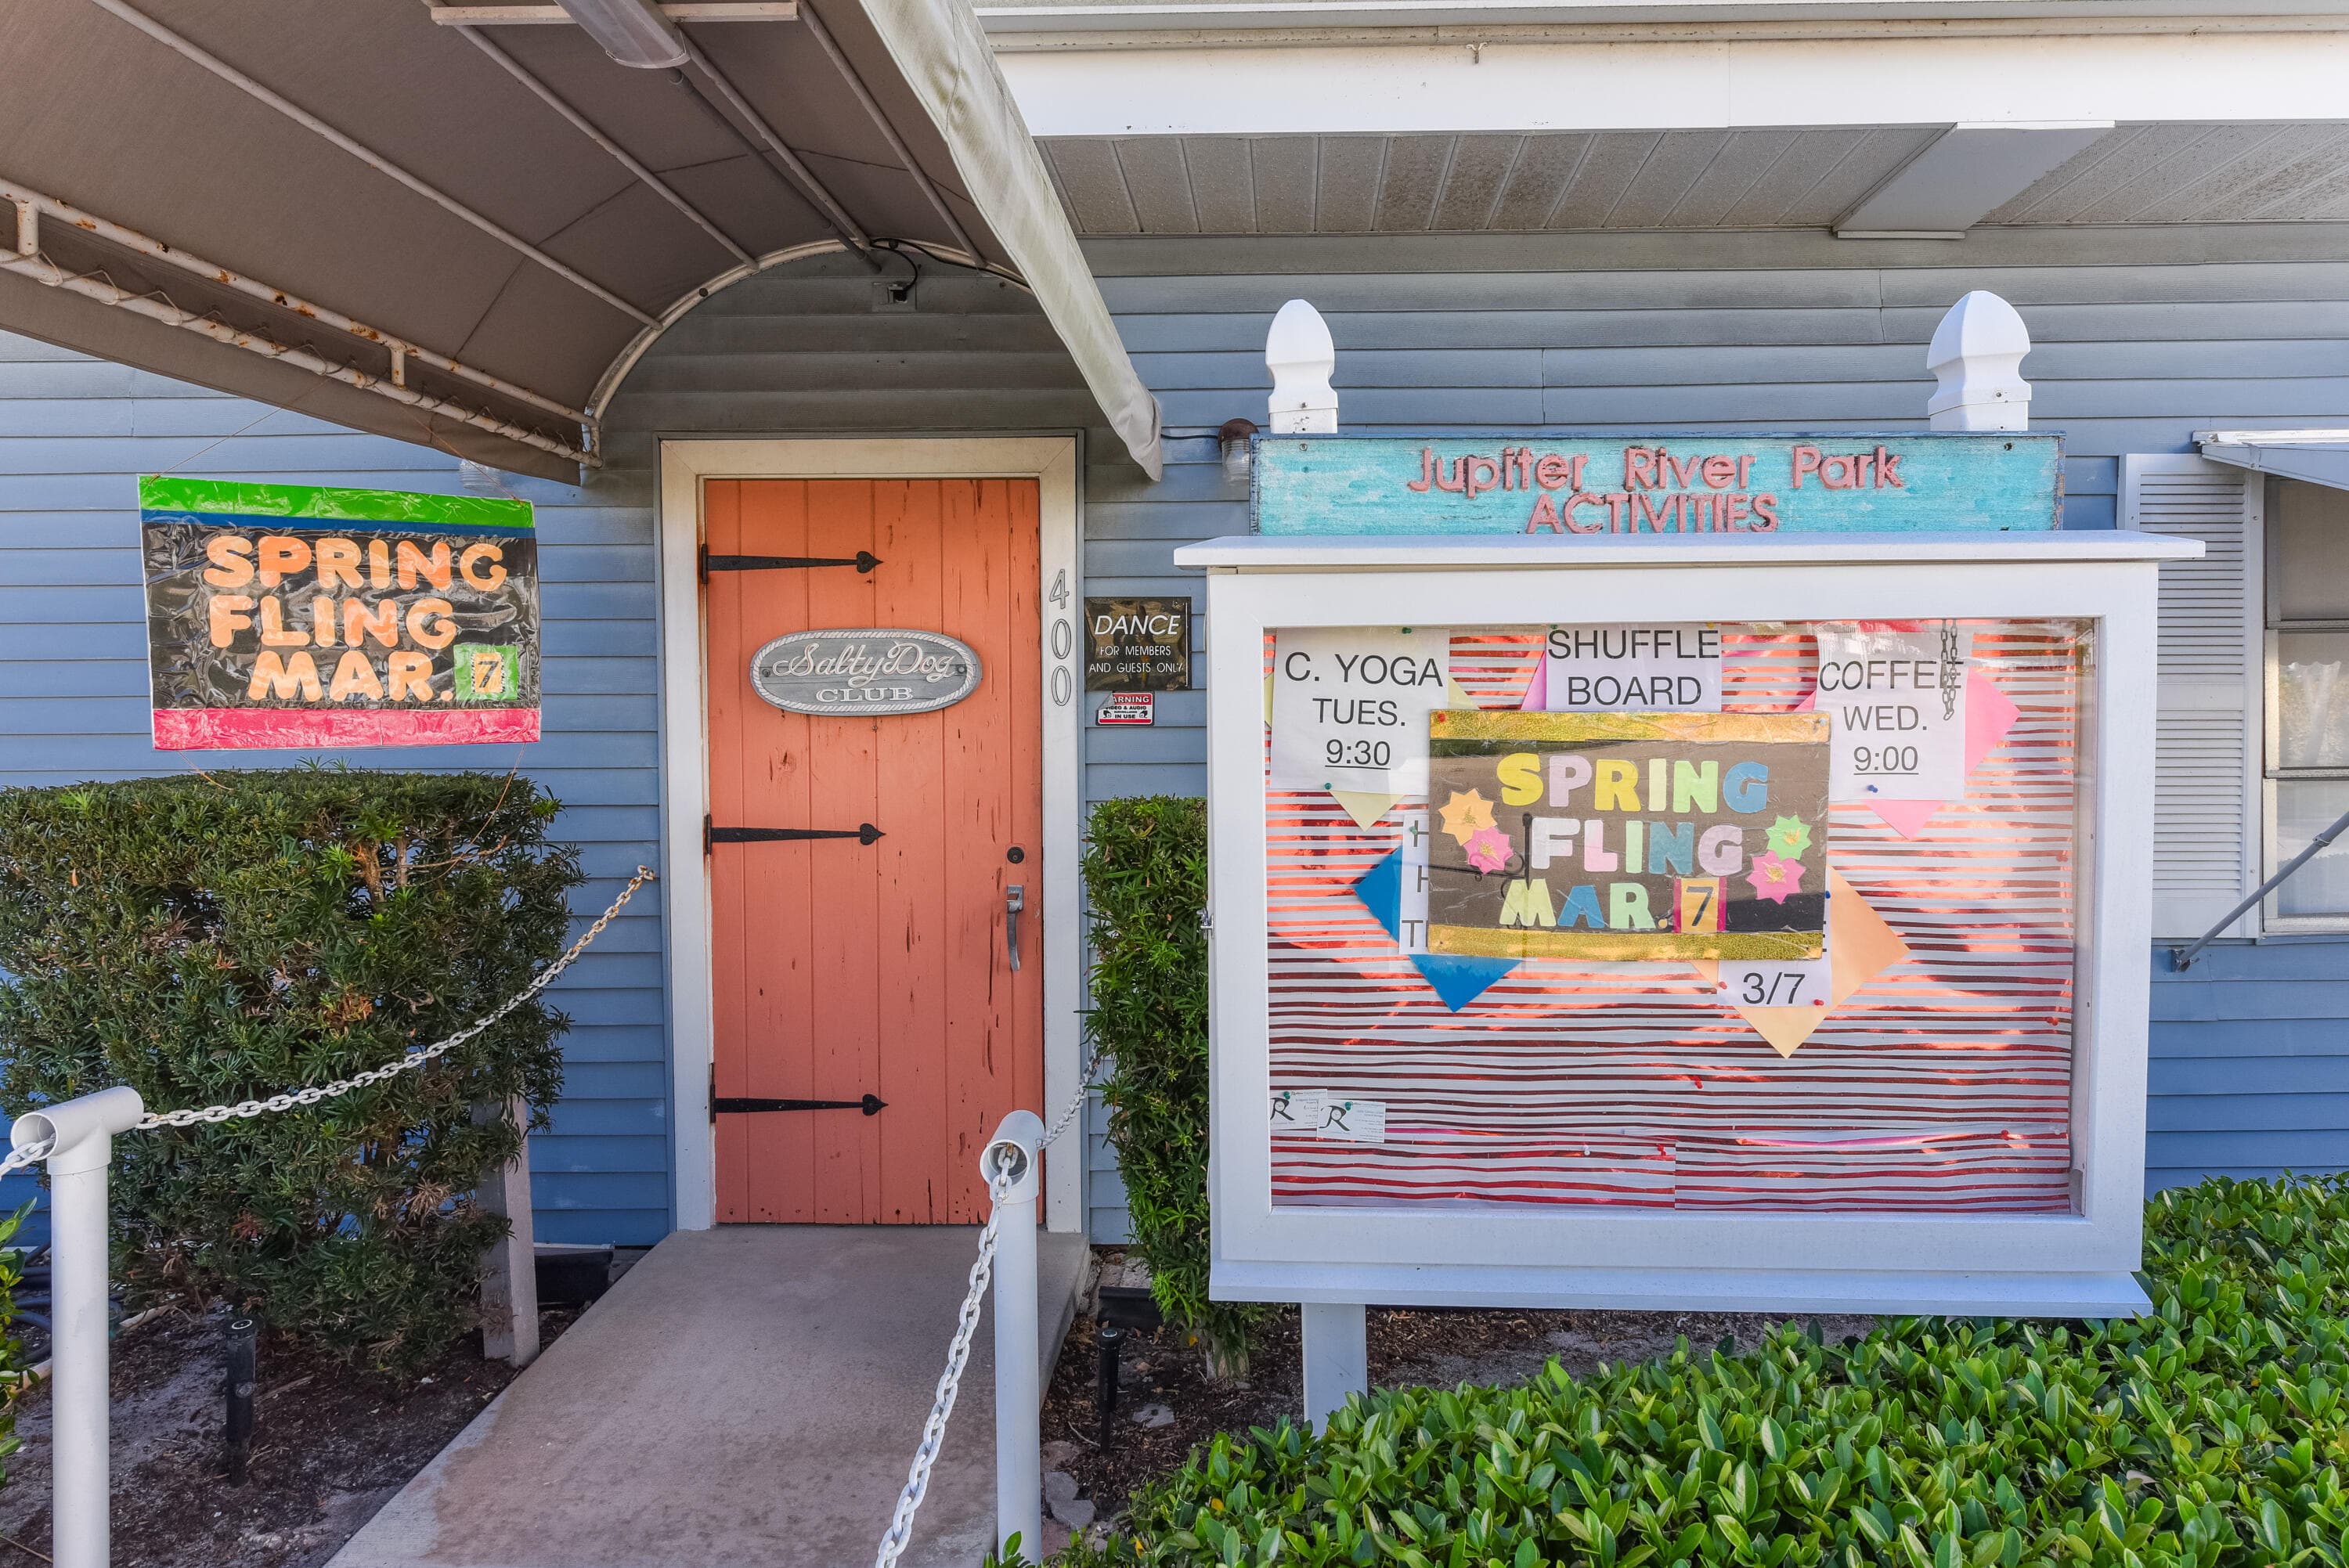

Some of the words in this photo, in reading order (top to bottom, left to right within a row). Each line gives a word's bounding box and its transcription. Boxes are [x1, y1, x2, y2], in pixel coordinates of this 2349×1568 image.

[1407, 446, 1589, 499] Jupiter
[1624, 445, 1756, 491] River
[1792, 445, 1903, 490] Park
[1527, 492, 1778, 534] ACTIVITIES
[204, 535, 507, 592] SPRING
[209, 595, 457, 650] FLING
[1049, 568, 1072, 706] 400
[1095, 615, 1181, 635] DANCE
[1100, 645, 1120, 656] FOR
[1125, 645, 1171, 656] MEMBERS
[1548, 629, 1720, 659] SHUFFLE
[247, 651, 455, 701] MAR.
[477, 661, 499, 689] 7
[773, 643, 886, 688] Salty
[882, 640, 957, 683] Dog
[1089, 663, 1111, 673] AND
[1117, 662, 1151, 673] GUESTS
[1156, 662, 1183, 673] ONLY
[1285, 651, 1320, 682] C.
[1335, 654, 1444, 687] YOGA
[1819, 660, 1965, 692] COFFEE
[816, 687, 915, 703] CLUB
[1568, 676, 1702, 706] BOARD
[1313, 697, 1406, 727] TUES.
[1843, 705, 1927, 731] WED.
[1326, 738, 1391, 767] 9:30
[1854, 745, 1918, 773] 9:00
[1496, 752, 1769, 814] SPRING
[1531, 817, 1743, 877] FLING
[1499, 878, 1669, 929] MAR.
[1687, 886, 1715, 927] 7
[1742, 971, 1806, 1005] 3/7
